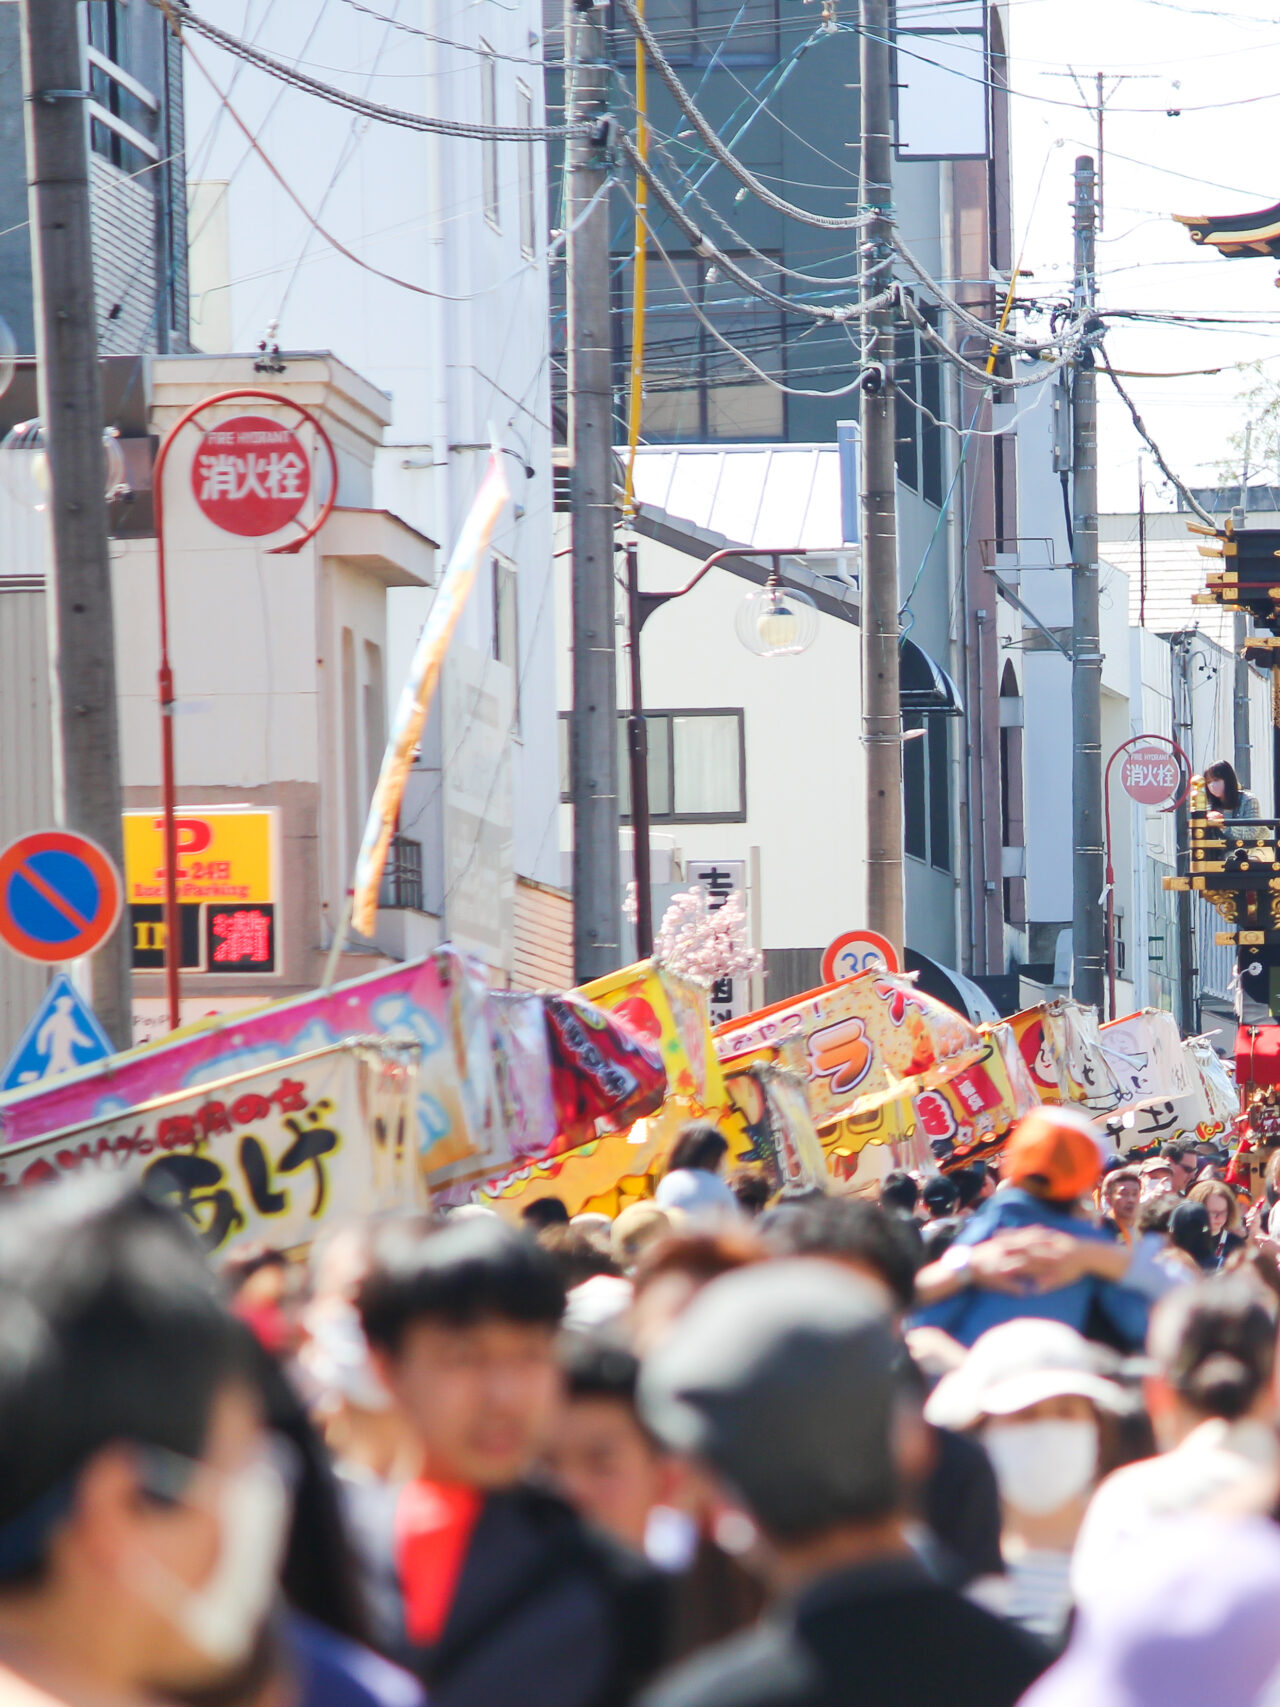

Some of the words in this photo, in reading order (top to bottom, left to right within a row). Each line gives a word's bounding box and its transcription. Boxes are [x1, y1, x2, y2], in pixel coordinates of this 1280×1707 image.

[199, 452, 305, 500] 消火栓
[1126, 764, 1174, 787] 消火栓
[153, 818, 212, 881] P
[841, 952, 881, 978] 30
